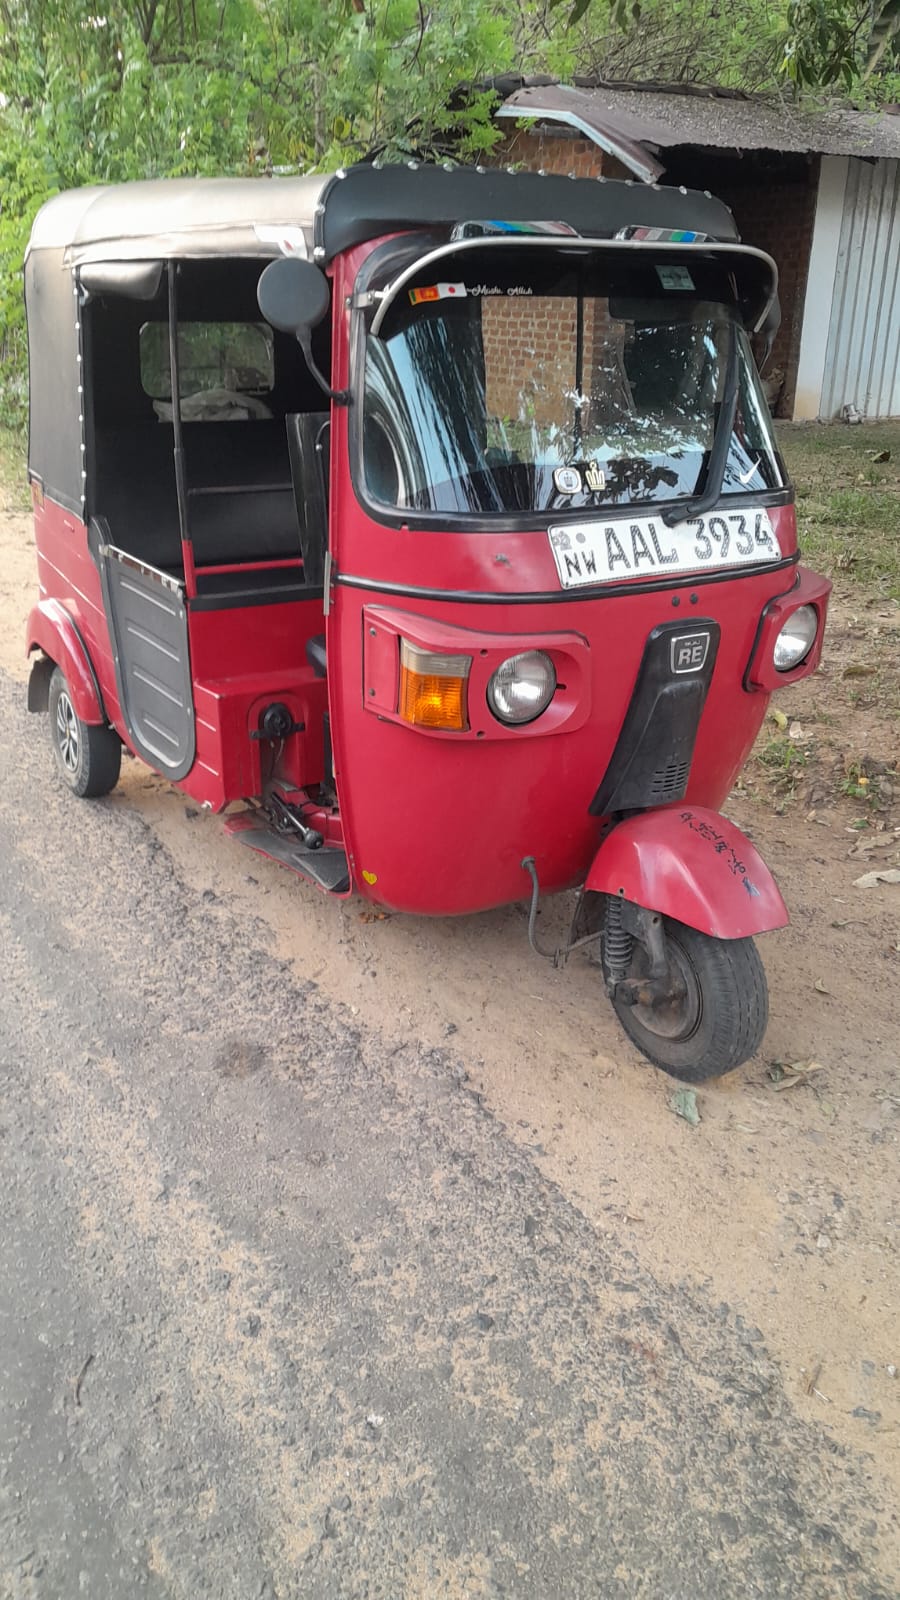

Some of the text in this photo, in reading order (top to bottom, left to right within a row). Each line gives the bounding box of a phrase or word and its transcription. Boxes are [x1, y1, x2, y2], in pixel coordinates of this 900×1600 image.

[564, 514, 774, 577] NW AAL 3934
[678, 645, 703, 666] RE
